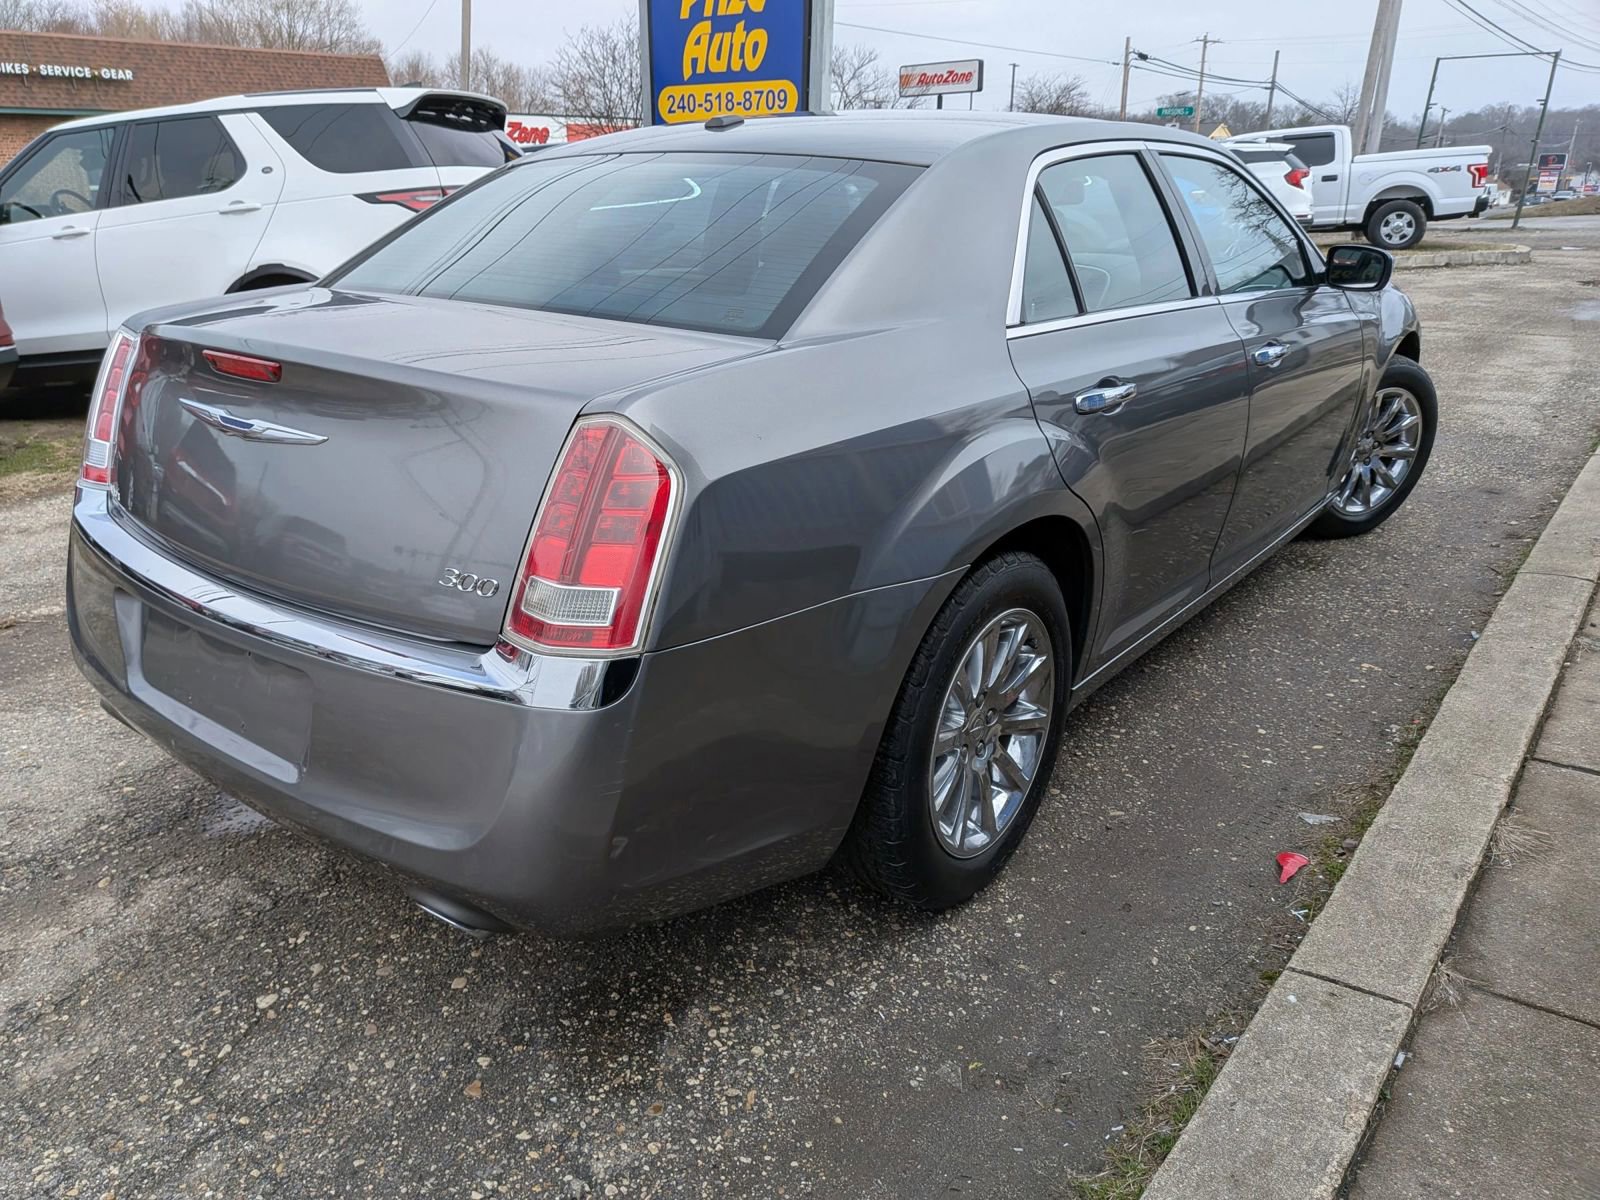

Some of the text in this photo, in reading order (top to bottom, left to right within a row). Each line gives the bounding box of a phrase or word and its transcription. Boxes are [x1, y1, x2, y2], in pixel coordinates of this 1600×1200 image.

[682, 20, 768, 81] Auto
[0, 61, 134, 80] IKES SERVICE GEAR
[916, 70, 973, 86] AutoZone
[666, 88, 788, 114] 240-518-8709
[506, 121, 550, 144] Zone
[438, 567, 500, 597] 300
